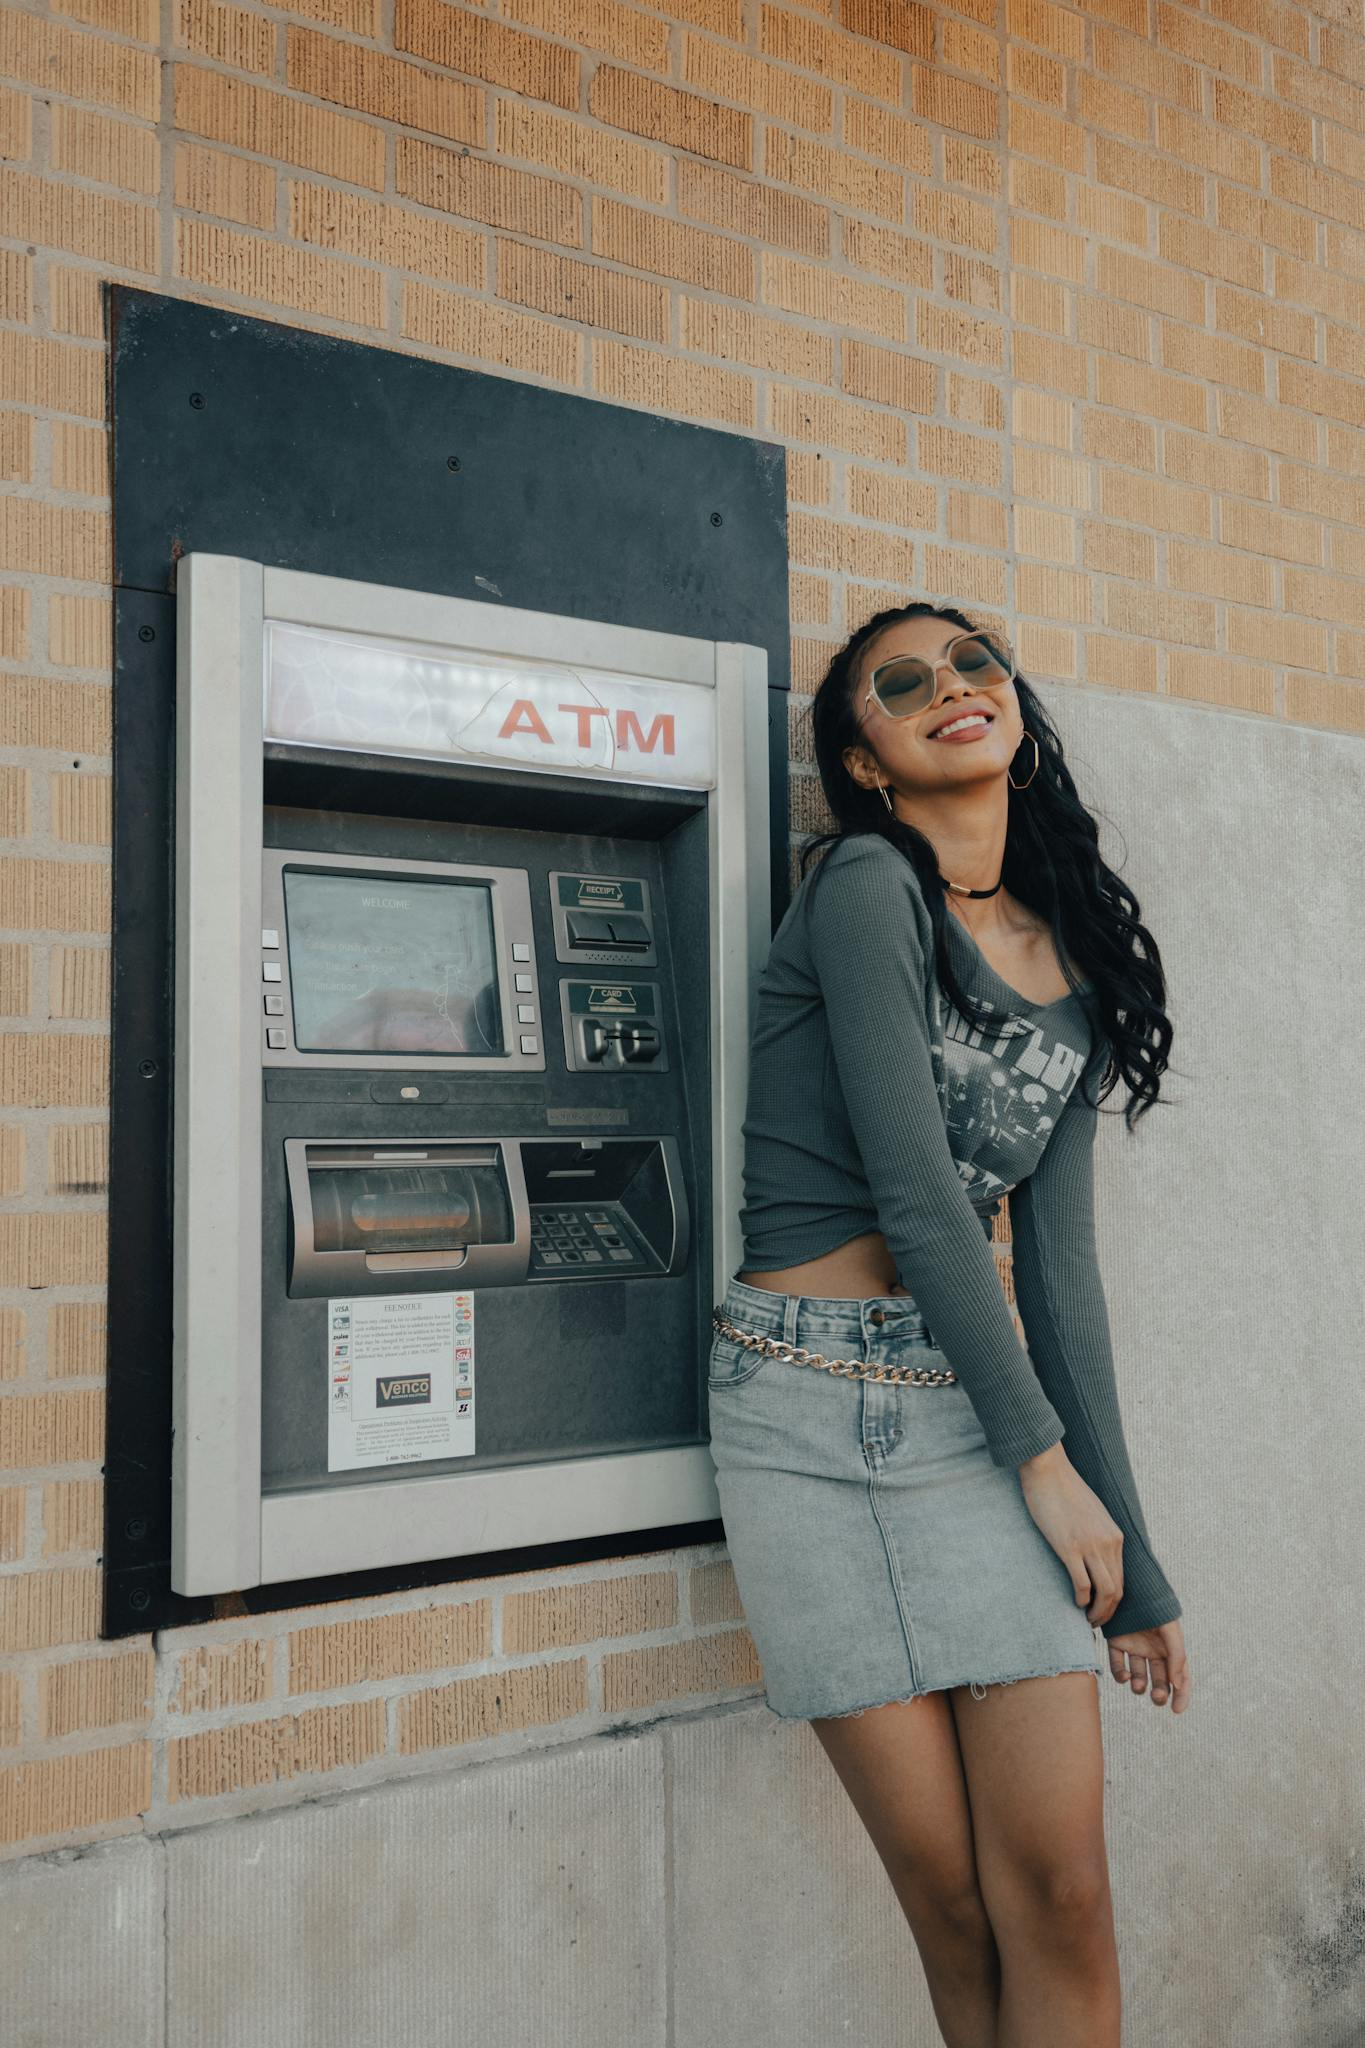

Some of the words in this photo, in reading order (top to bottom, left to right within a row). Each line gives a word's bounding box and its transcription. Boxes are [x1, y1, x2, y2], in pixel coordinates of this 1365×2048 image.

[497, 699, 676, 756] ATM
[586, 884, 615, 896] RECEIPT
[361, 896, 412, 911] WELCOME
[601, 988, 622, 998] CARD
[334, 1305, 349, 1313] VISA
[380, 1378, 430, 1400] Venco
